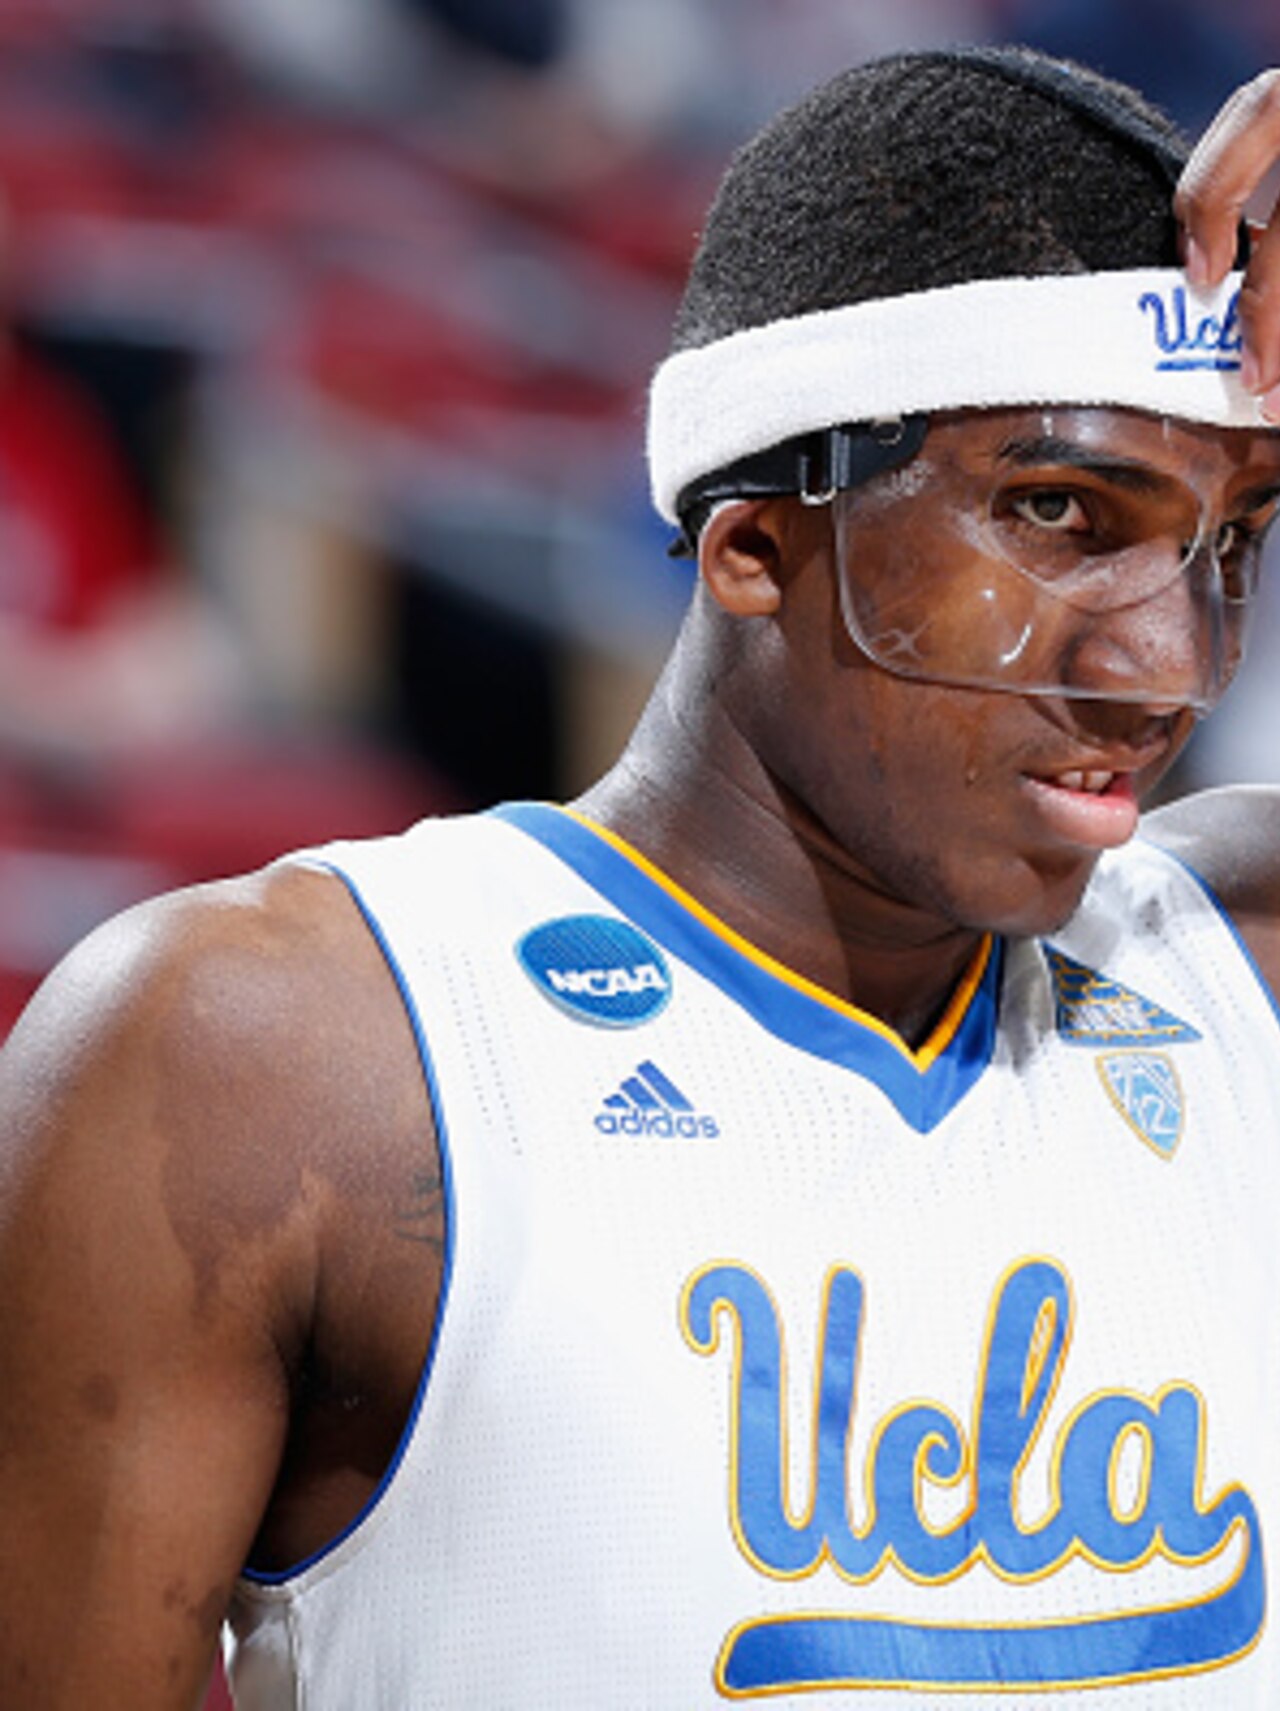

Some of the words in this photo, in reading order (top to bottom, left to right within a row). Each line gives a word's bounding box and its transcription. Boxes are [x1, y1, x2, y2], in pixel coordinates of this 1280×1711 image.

[546, 963, 669, 997] NCAA
[594, 1107, 720, 1139] adidas
[680, 1255, 1267, 1700] Ucla
